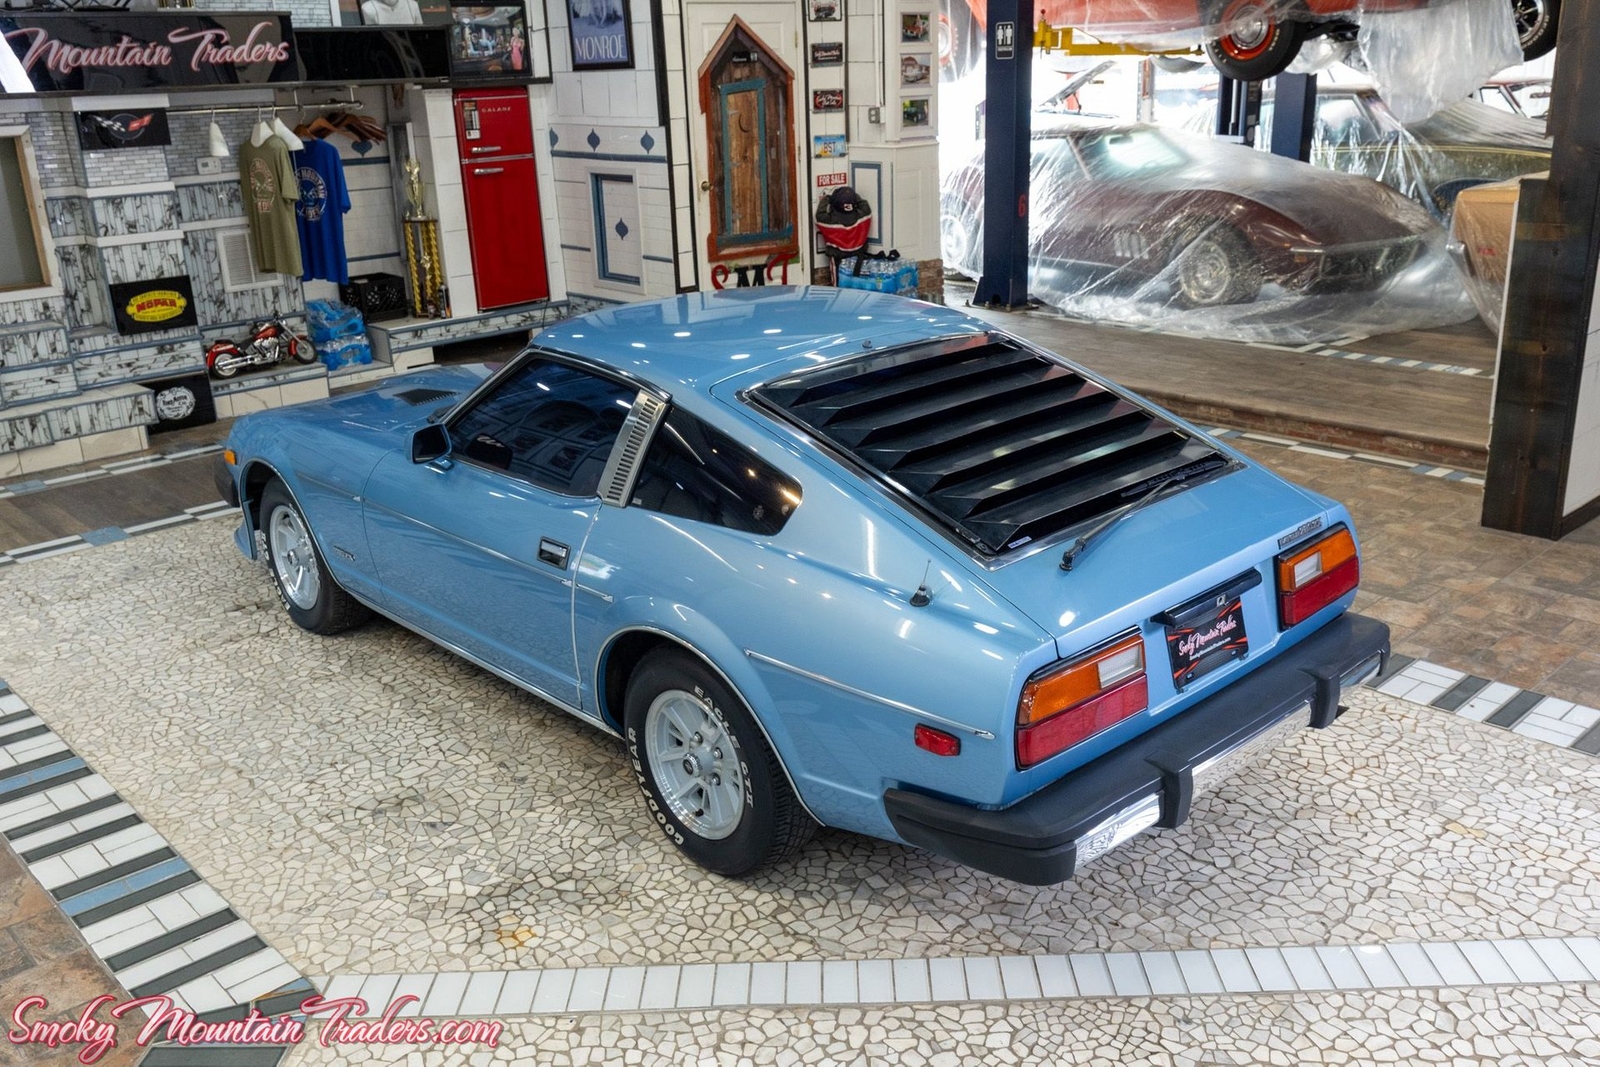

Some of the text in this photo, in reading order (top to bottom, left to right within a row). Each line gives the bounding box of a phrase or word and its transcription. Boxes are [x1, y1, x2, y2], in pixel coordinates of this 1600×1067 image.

[4, 21, 290, 75] Mountain Traders
[574, 33, 627, 60] MONROE
[818, 173, 846, 186] FOR SALE
[135, 297, 178, 313] MOPAR
[694, 685, 741, 749] EAGLE
[628, 727, 685, 846] GOODYEAR
